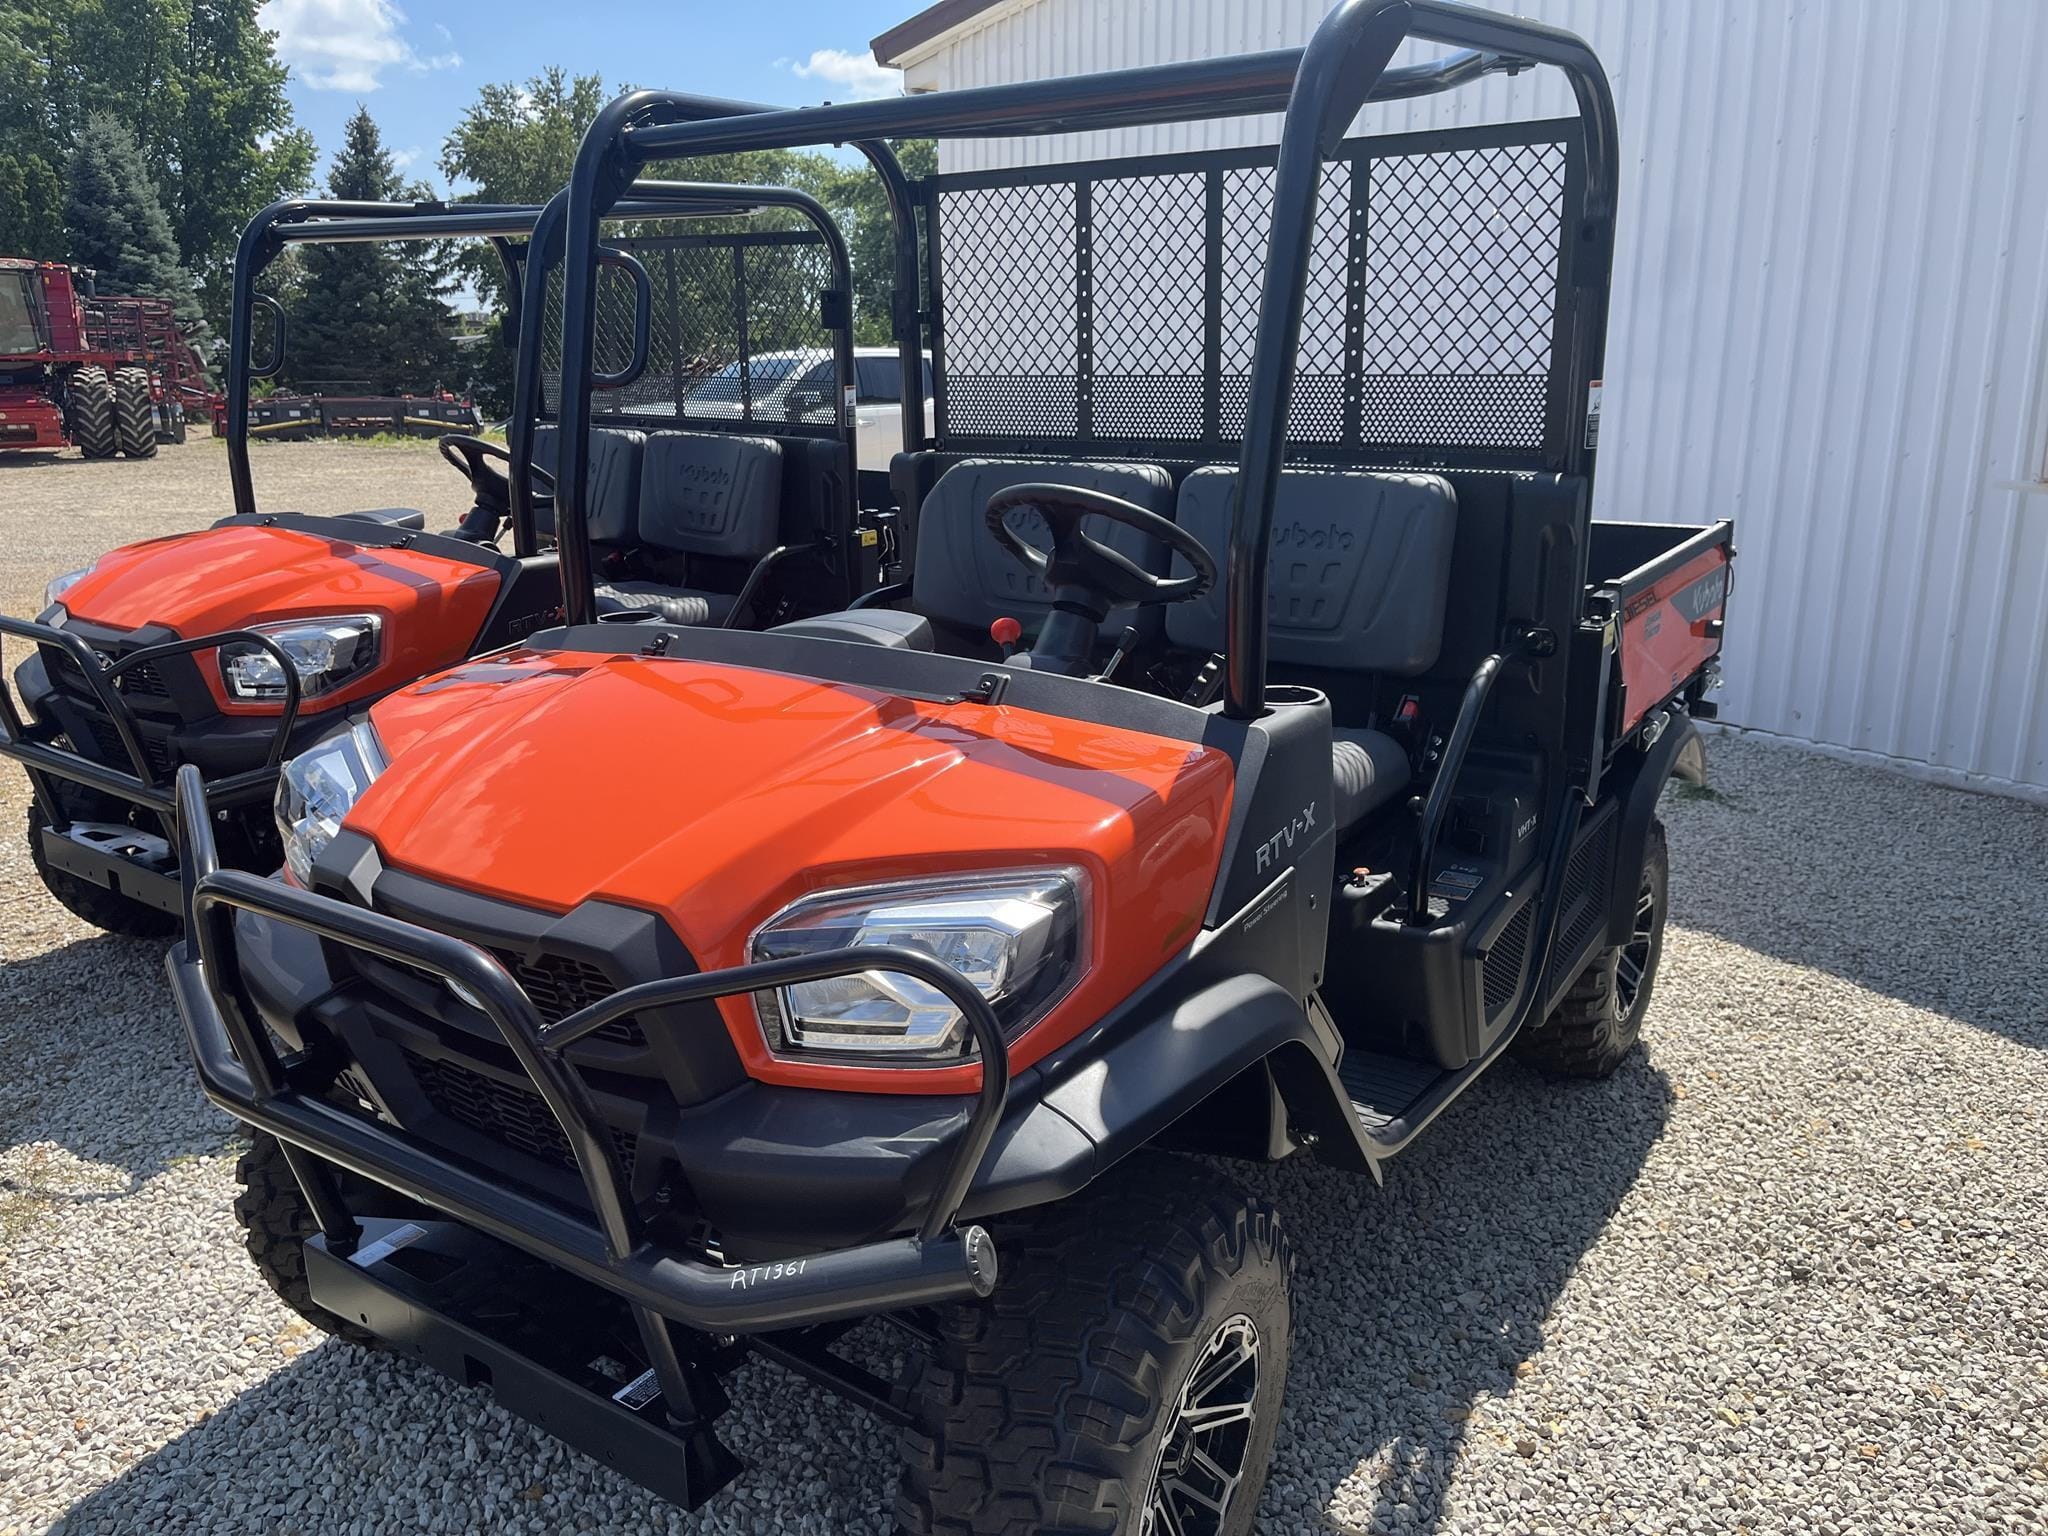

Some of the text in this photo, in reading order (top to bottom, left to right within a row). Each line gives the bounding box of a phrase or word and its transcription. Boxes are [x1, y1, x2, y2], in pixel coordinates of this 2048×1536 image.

[1271, 521, 1355, 550] ubota
[1255, 801, 1316, 875] RTV-X
[1244, 889, 1289, 932] Power Steering
[731, 1260, 806, 1290] RT1361
